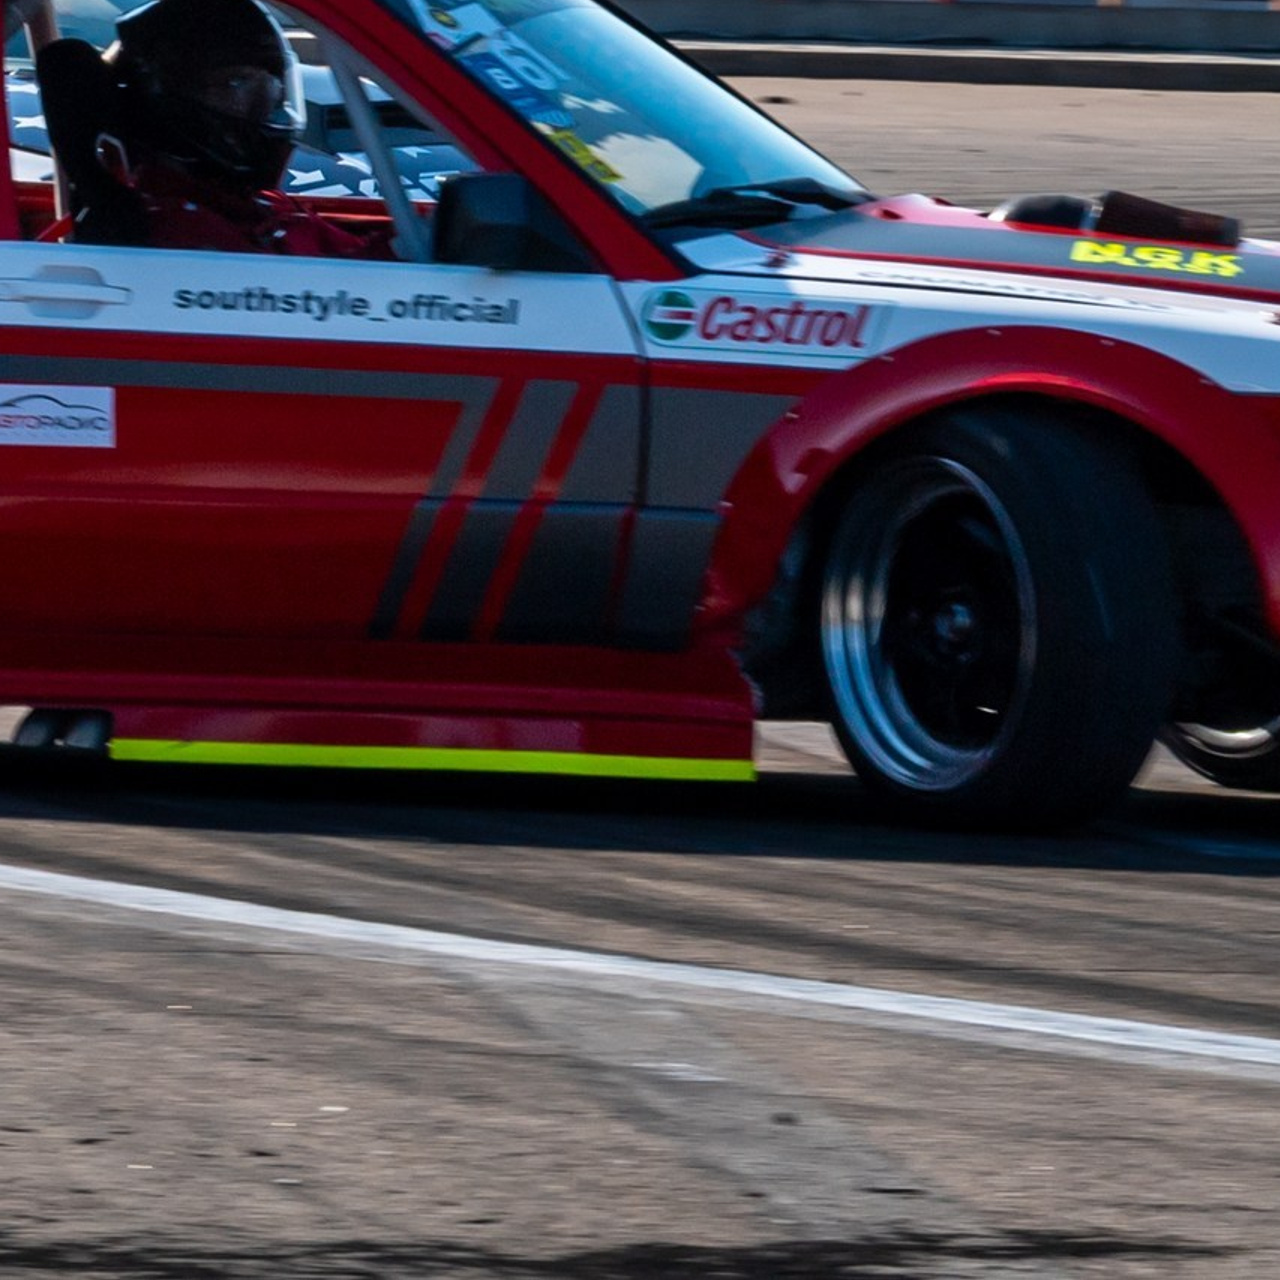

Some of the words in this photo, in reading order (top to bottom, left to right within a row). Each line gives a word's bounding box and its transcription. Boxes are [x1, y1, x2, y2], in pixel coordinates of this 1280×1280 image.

[1070, 240, 1244, 272] NGK
[173, 286, 519, 324] southstyle_official
[699, 295, 867, 348] Castrol
